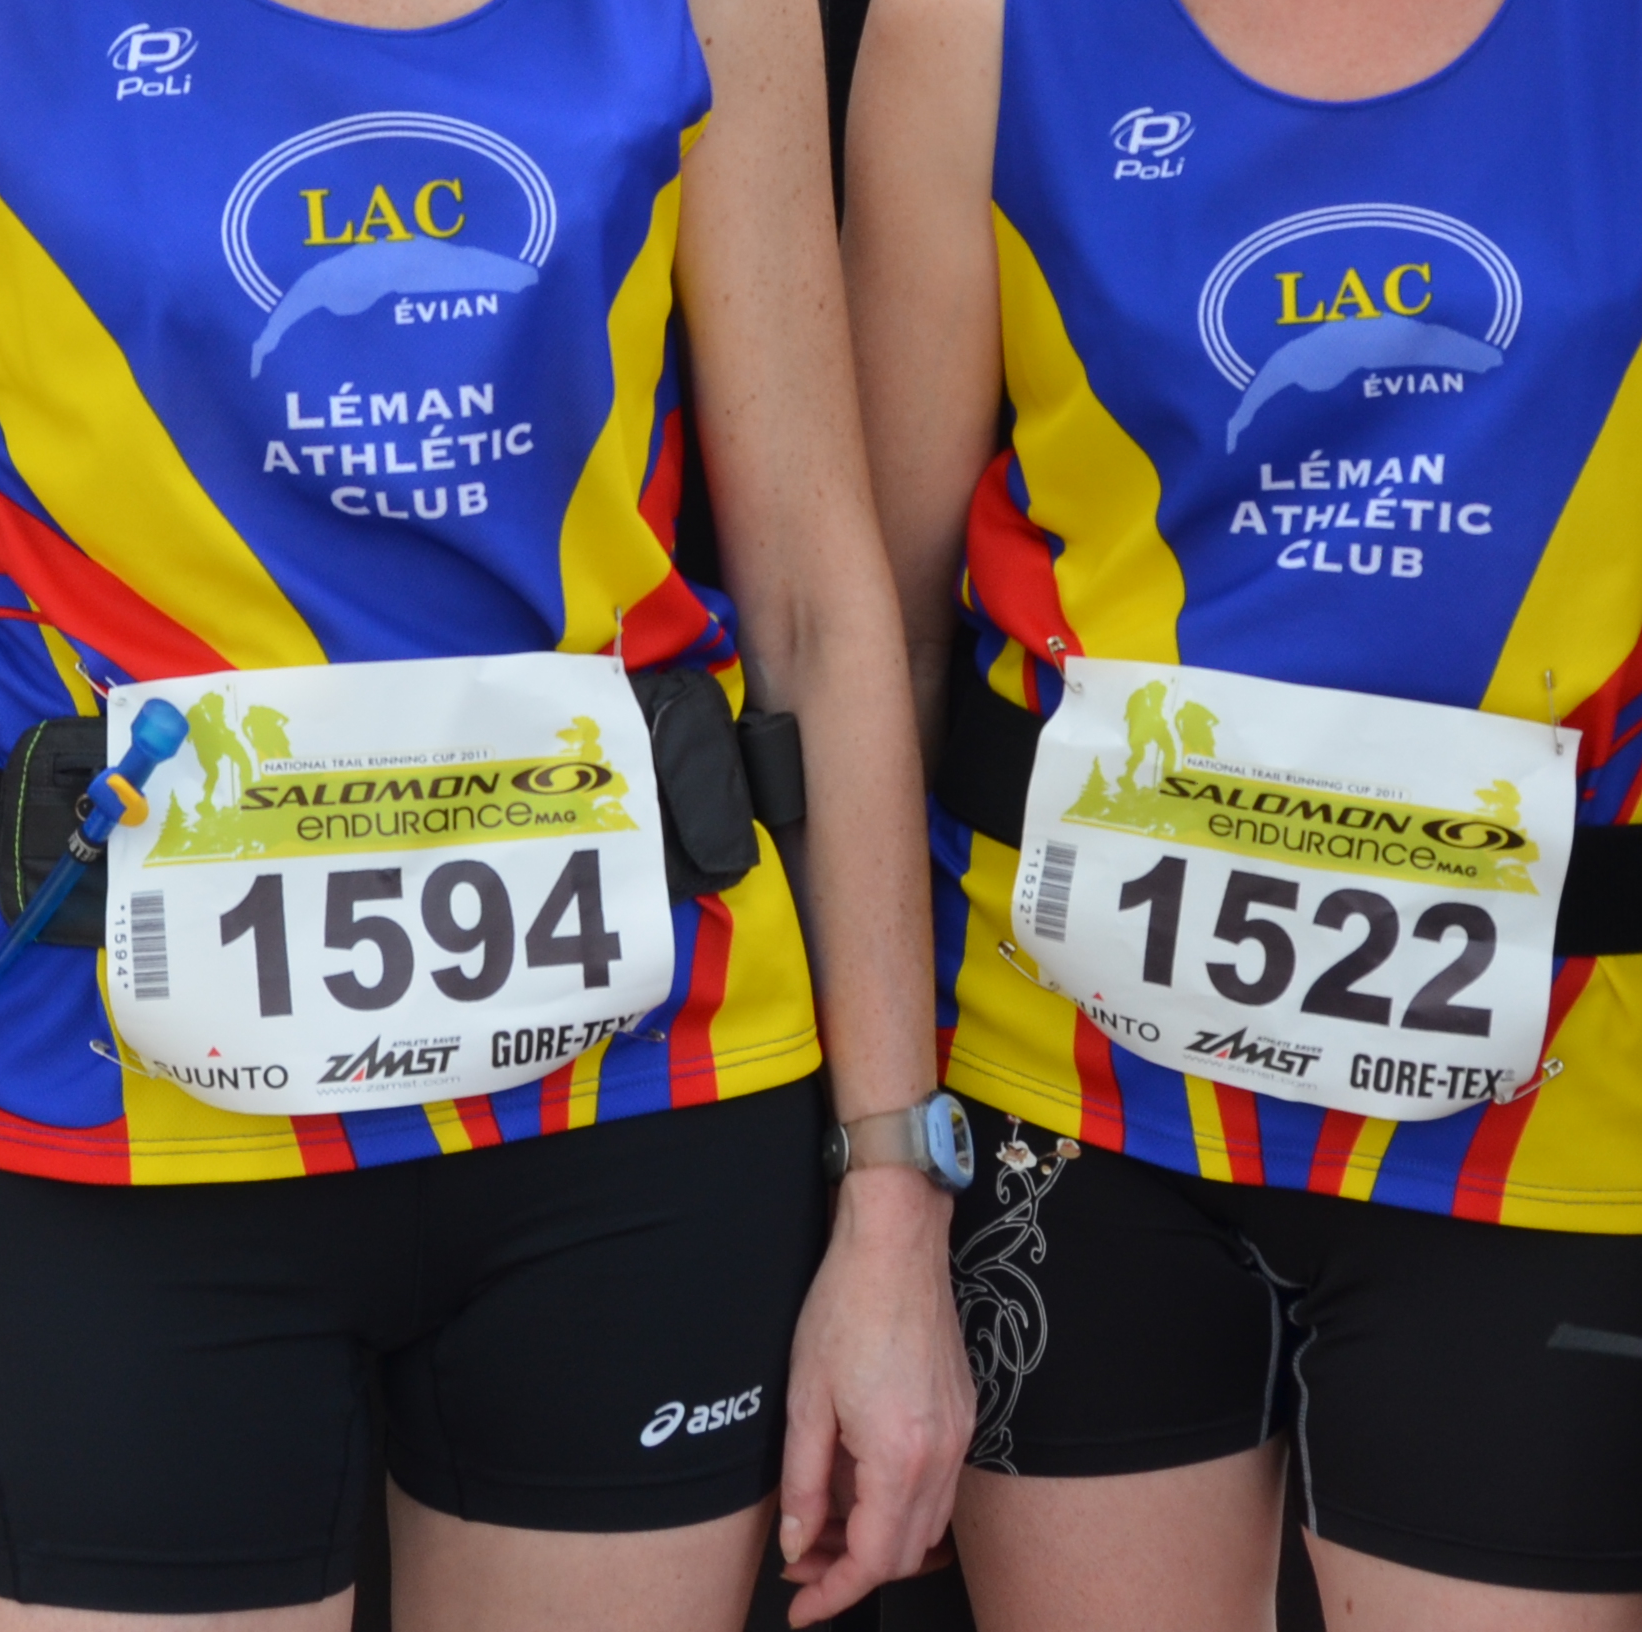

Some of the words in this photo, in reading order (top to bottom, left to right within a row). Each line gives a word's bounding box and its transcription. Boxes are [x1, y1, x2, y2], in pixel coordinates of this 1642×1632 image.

[299, 178, 466, 246] LAC
[395, 295, 498, 324] ÉVIAN
[1274, 262, 1432, 325] LAC
[286, 383, 495, 430] LÉMAN
[1363, 373, 1463, 398] ÉVIAN
[263, 423, 534, 476] ATHLÉTIC
[1260, 449, 1445, 491] LÉMAN
[330, 482, 488, 520] CLUB
[1230, 488, 1493, 536] ATHLÉTIC
[1277, 539, 1423, 578] CLUB
[265, 761, 327, 773] NATIONAL
[332, 757, 363, 769] TRAIL
[368, 754, 427, 766] RUNNING
[432, 753, 456, 763] CUP
[462, 750, 488, 761] 2011
[1187, 756, 1246, 777] NATIONAL
[1250, 768, 1281, 782] TRAIL
[1286, 773, 1343, 791] RUNNING
[1347, 783, 1371, 796] CUP
[1376, 787, 1404, 800] 2011
[240, 772, 499, 811] SALOMON
[1159, 776, 1412, 835] SALOMON
[219, 849, 622, 1017] 1594
[1118, 854, 1497, 1038] 1522
[1074, 997, 1160, 1043] UNTO
[1350, 1053, 1503, 1100] GORE-TEX
[686, 1385, 762, 1434] asics
